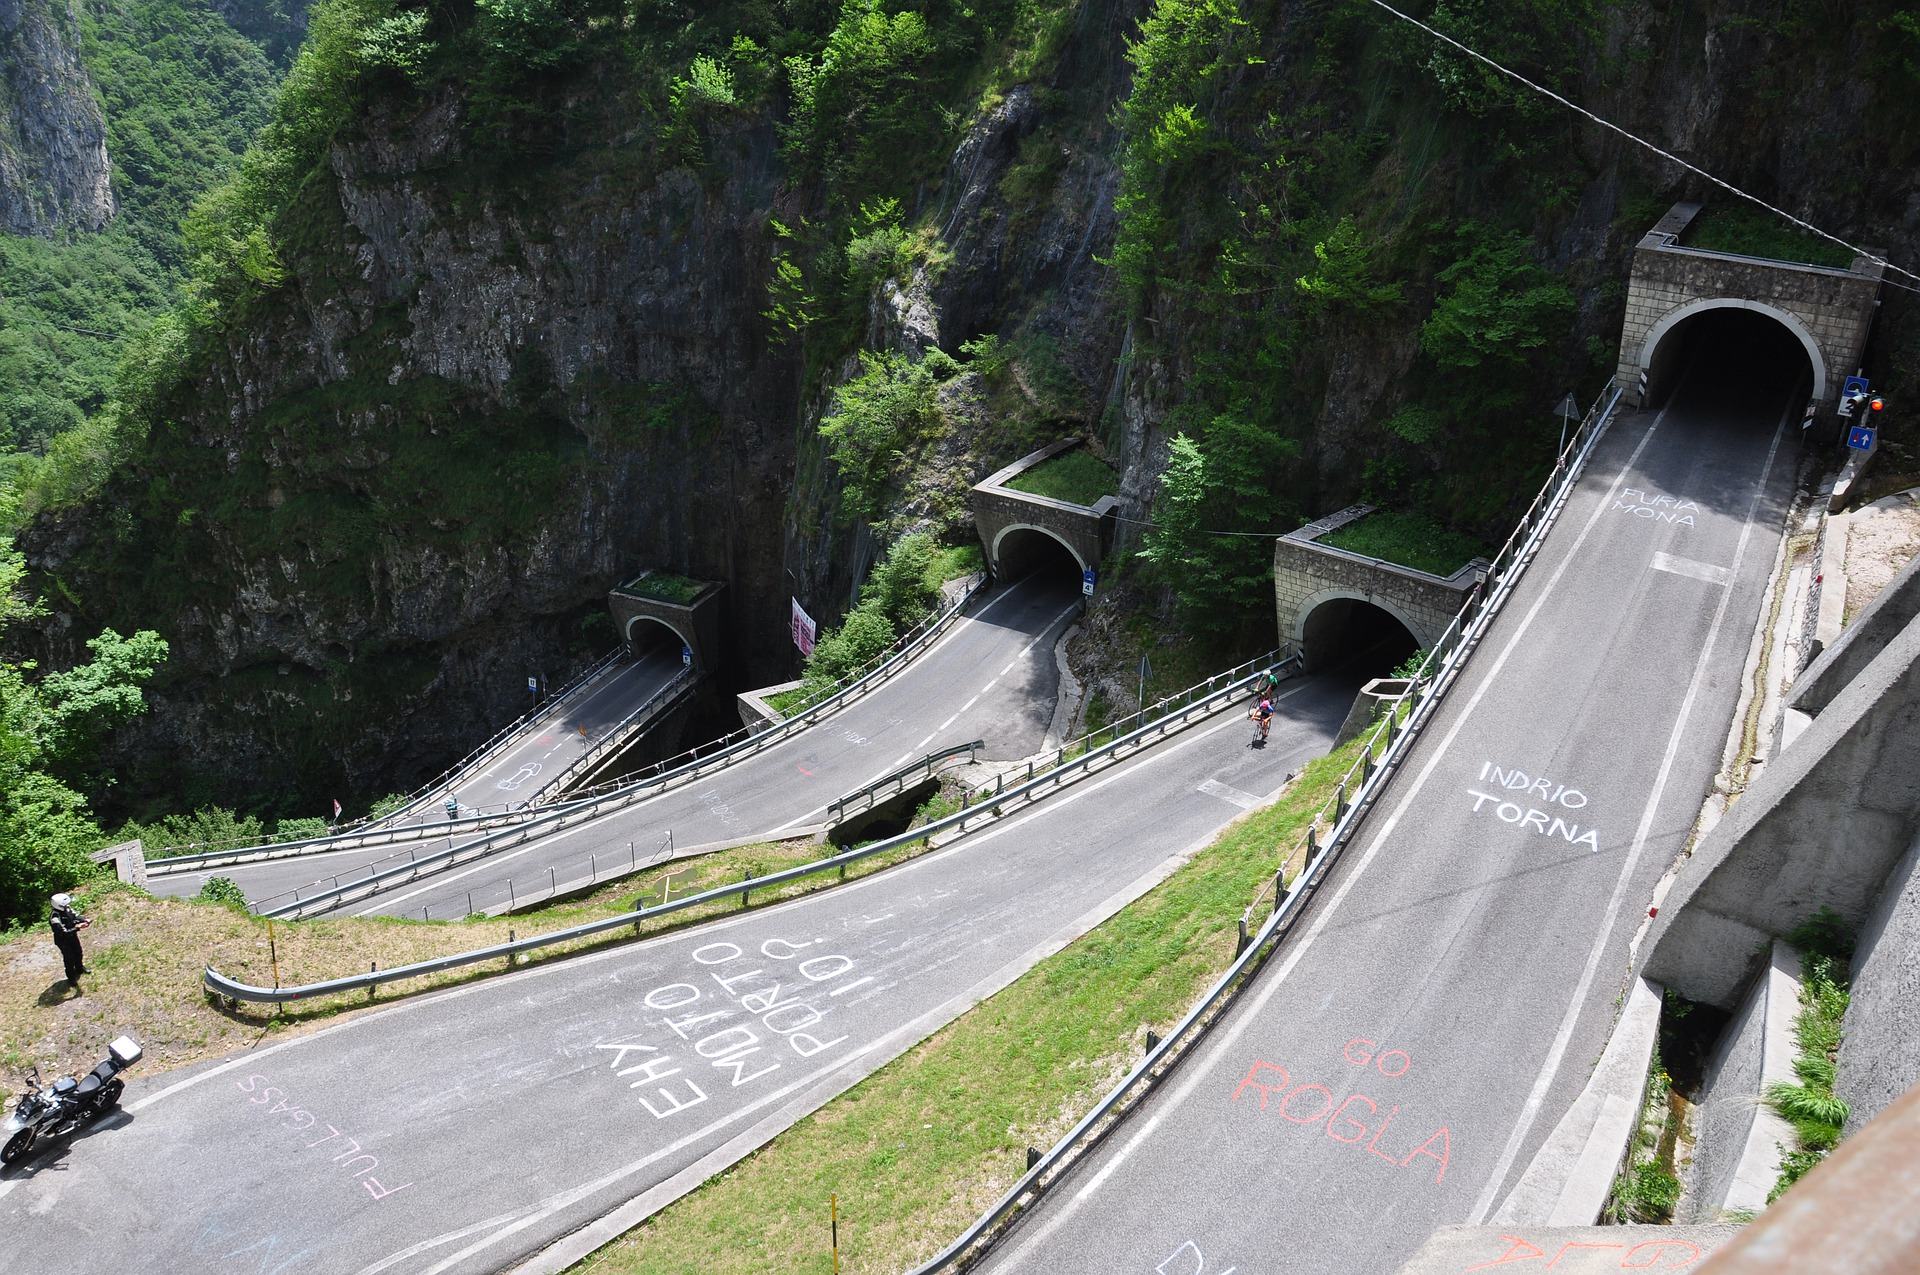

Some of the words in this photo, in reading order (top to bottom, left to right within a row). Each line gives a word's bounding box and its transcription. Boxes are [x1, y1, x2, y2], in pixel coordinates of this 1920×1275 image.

[1611, 500, 1695, 528] MONA
[1621, 488, 1699, 514] FURIA
[1479, 761, 1588, 809] INDRIO
[1467, 789, 1598, 852] TORNA
[692, 942, 849, 1057] PORTO
[645, 983, 780, 1086] MOTO
[1343, 1036, 1411, 1078] GO
[236, 1073, 315, 1130] GASS
[595, 1042, 708, 1119] EHY
[1230, 1059, 1454, 1184] ROGLA
[305, 1124, 413, 1200] FULL
